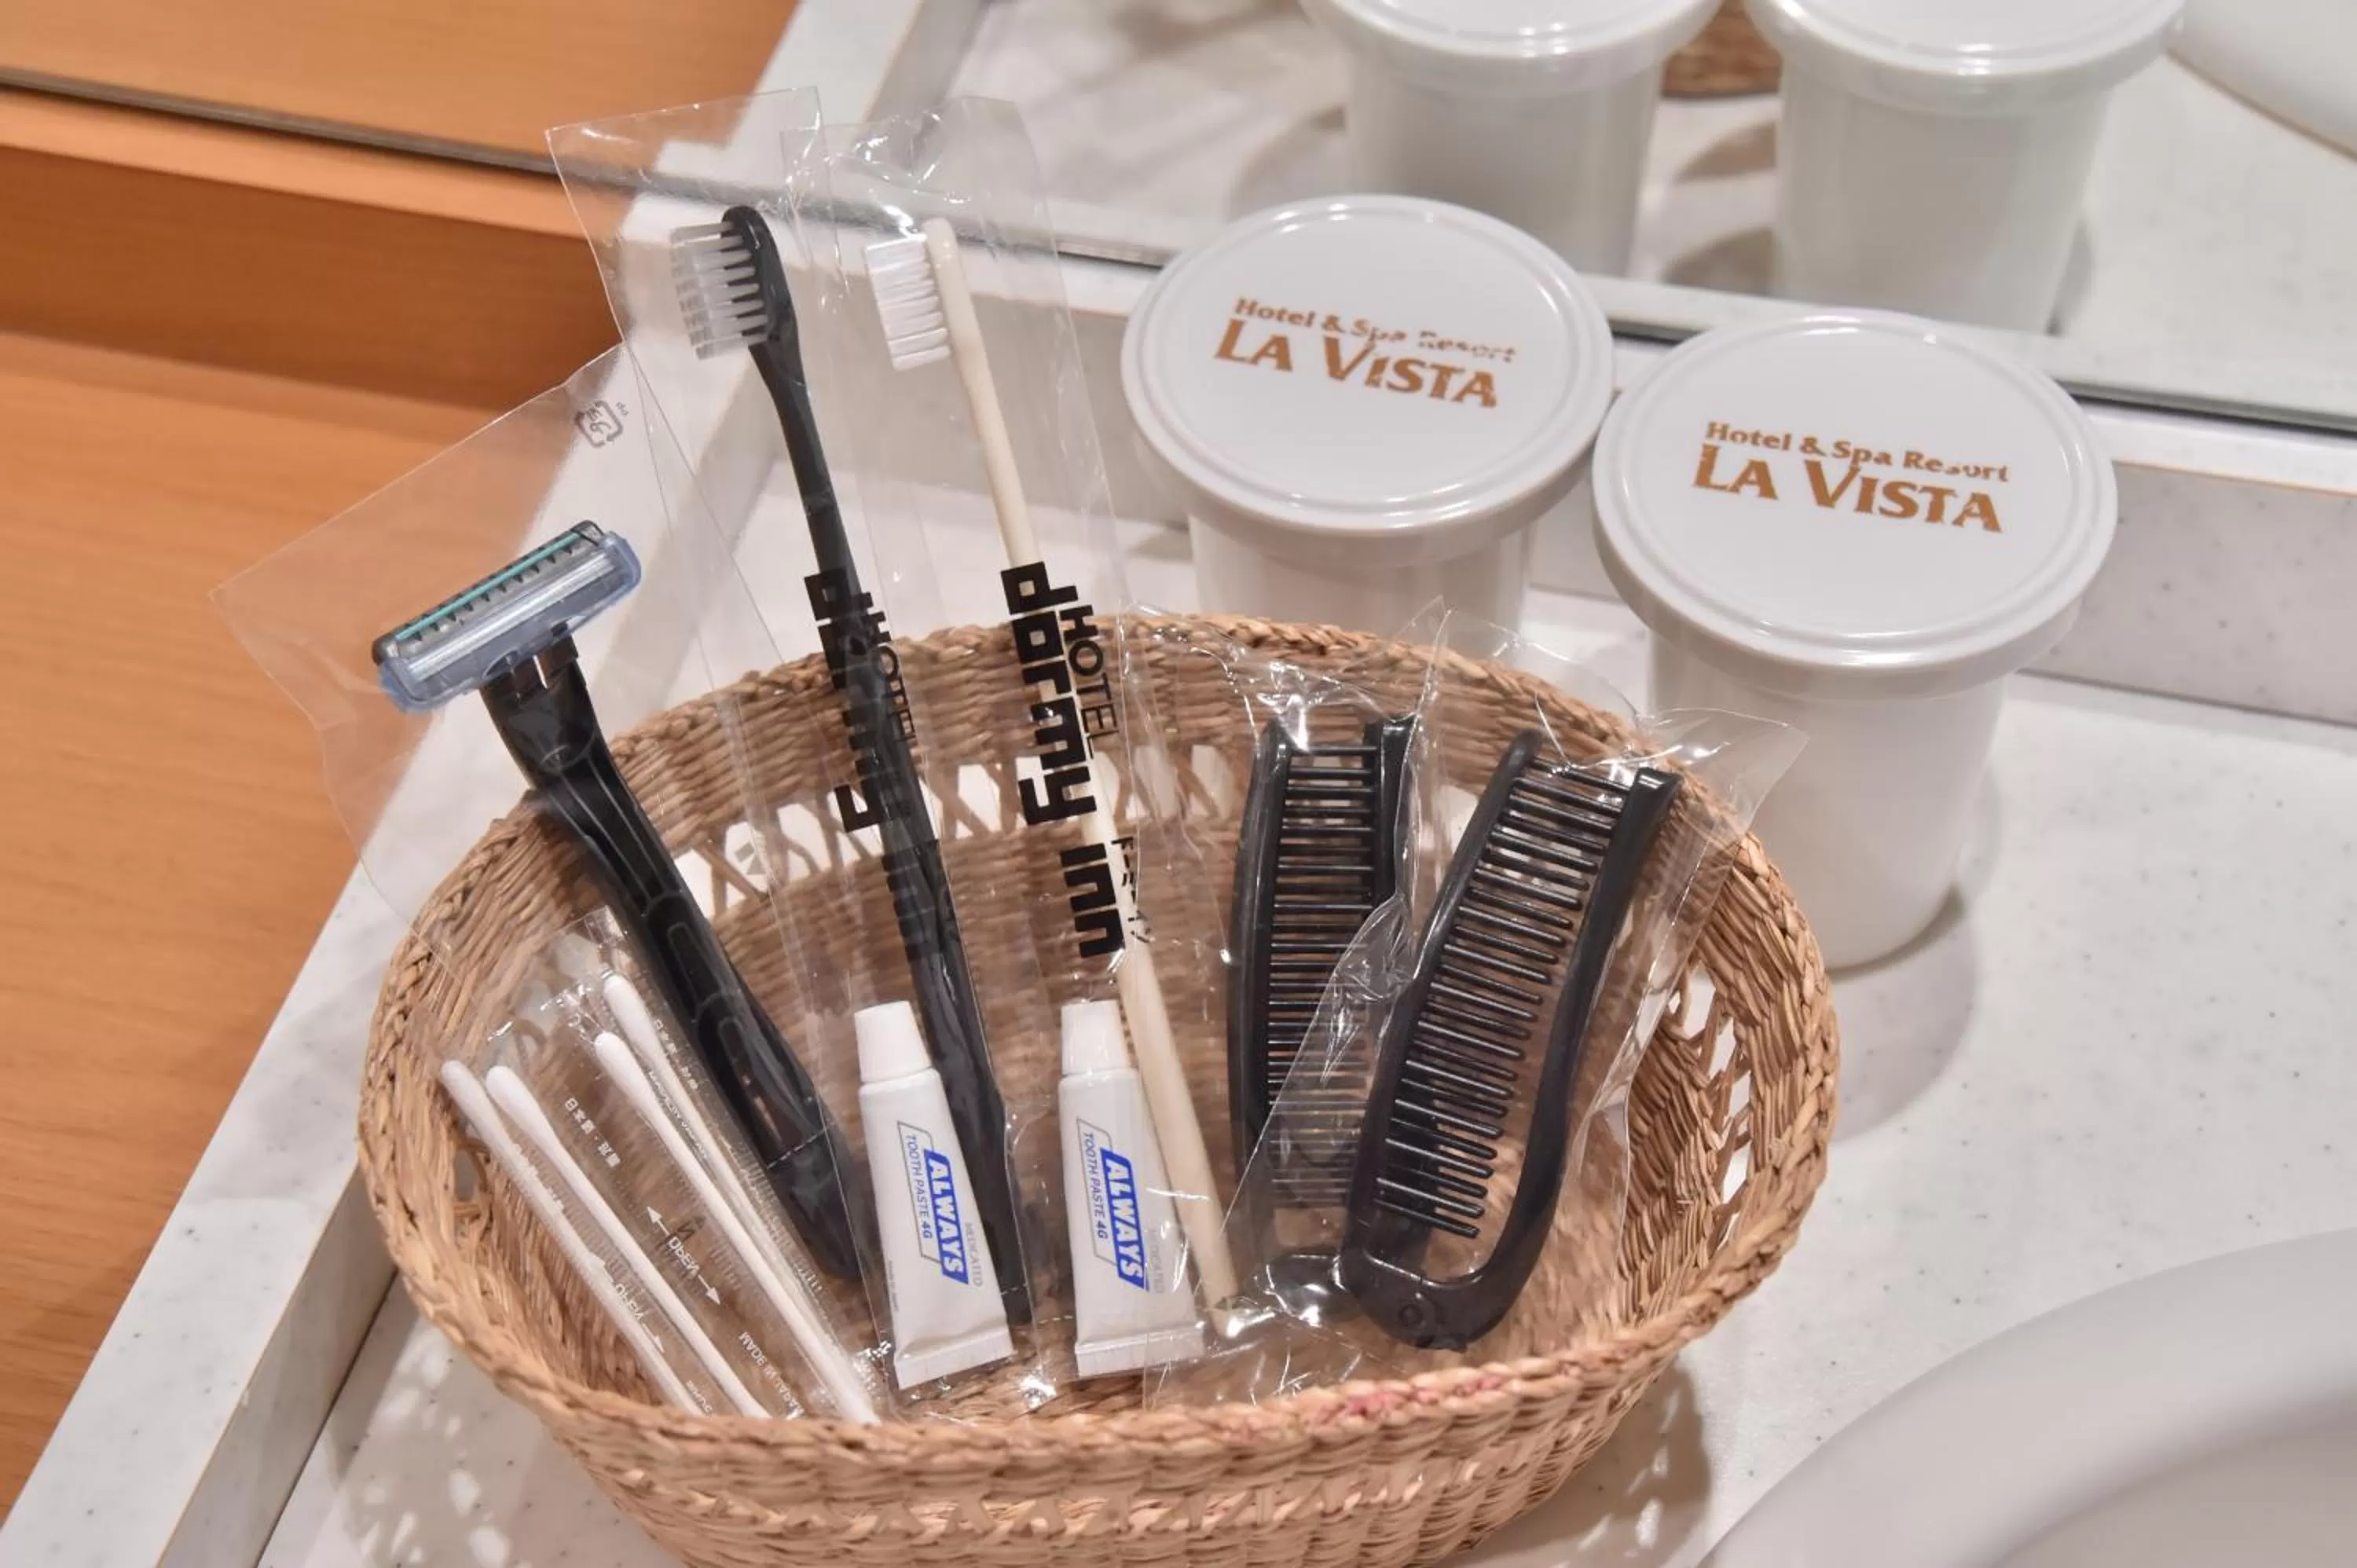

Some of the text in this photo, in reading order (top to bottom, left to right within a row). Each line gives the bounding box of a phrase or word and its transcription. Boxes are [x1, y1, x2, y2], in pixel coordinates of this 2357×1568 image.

[1215, 318, 1497, 408] LA VISTA
[1234, 297, 1316, 328] Hotel
[1321, 315, 1346, 333] &
[1692, 442, 2003, 533] LA VISTA
[1705, 421, 1792, 451] Hotel
[1799, 435, 1827, 456] &
[1831, 440, 1893, 466] Spa
[1000, 560, 1098, 826] dormy
[1059, 604, 1119, 760] HOTEL
[1060, 843, 1127, 958] inn
[905, 1134, 933, 1240] TOOTH PASTE 4G
[927, 1157, 965, 1275] ALWAYS
[1083, 1131, 1109, 1240] TOOTH PASTE 4G
[1105, 1159, 1143, 1279] ALWAYS
